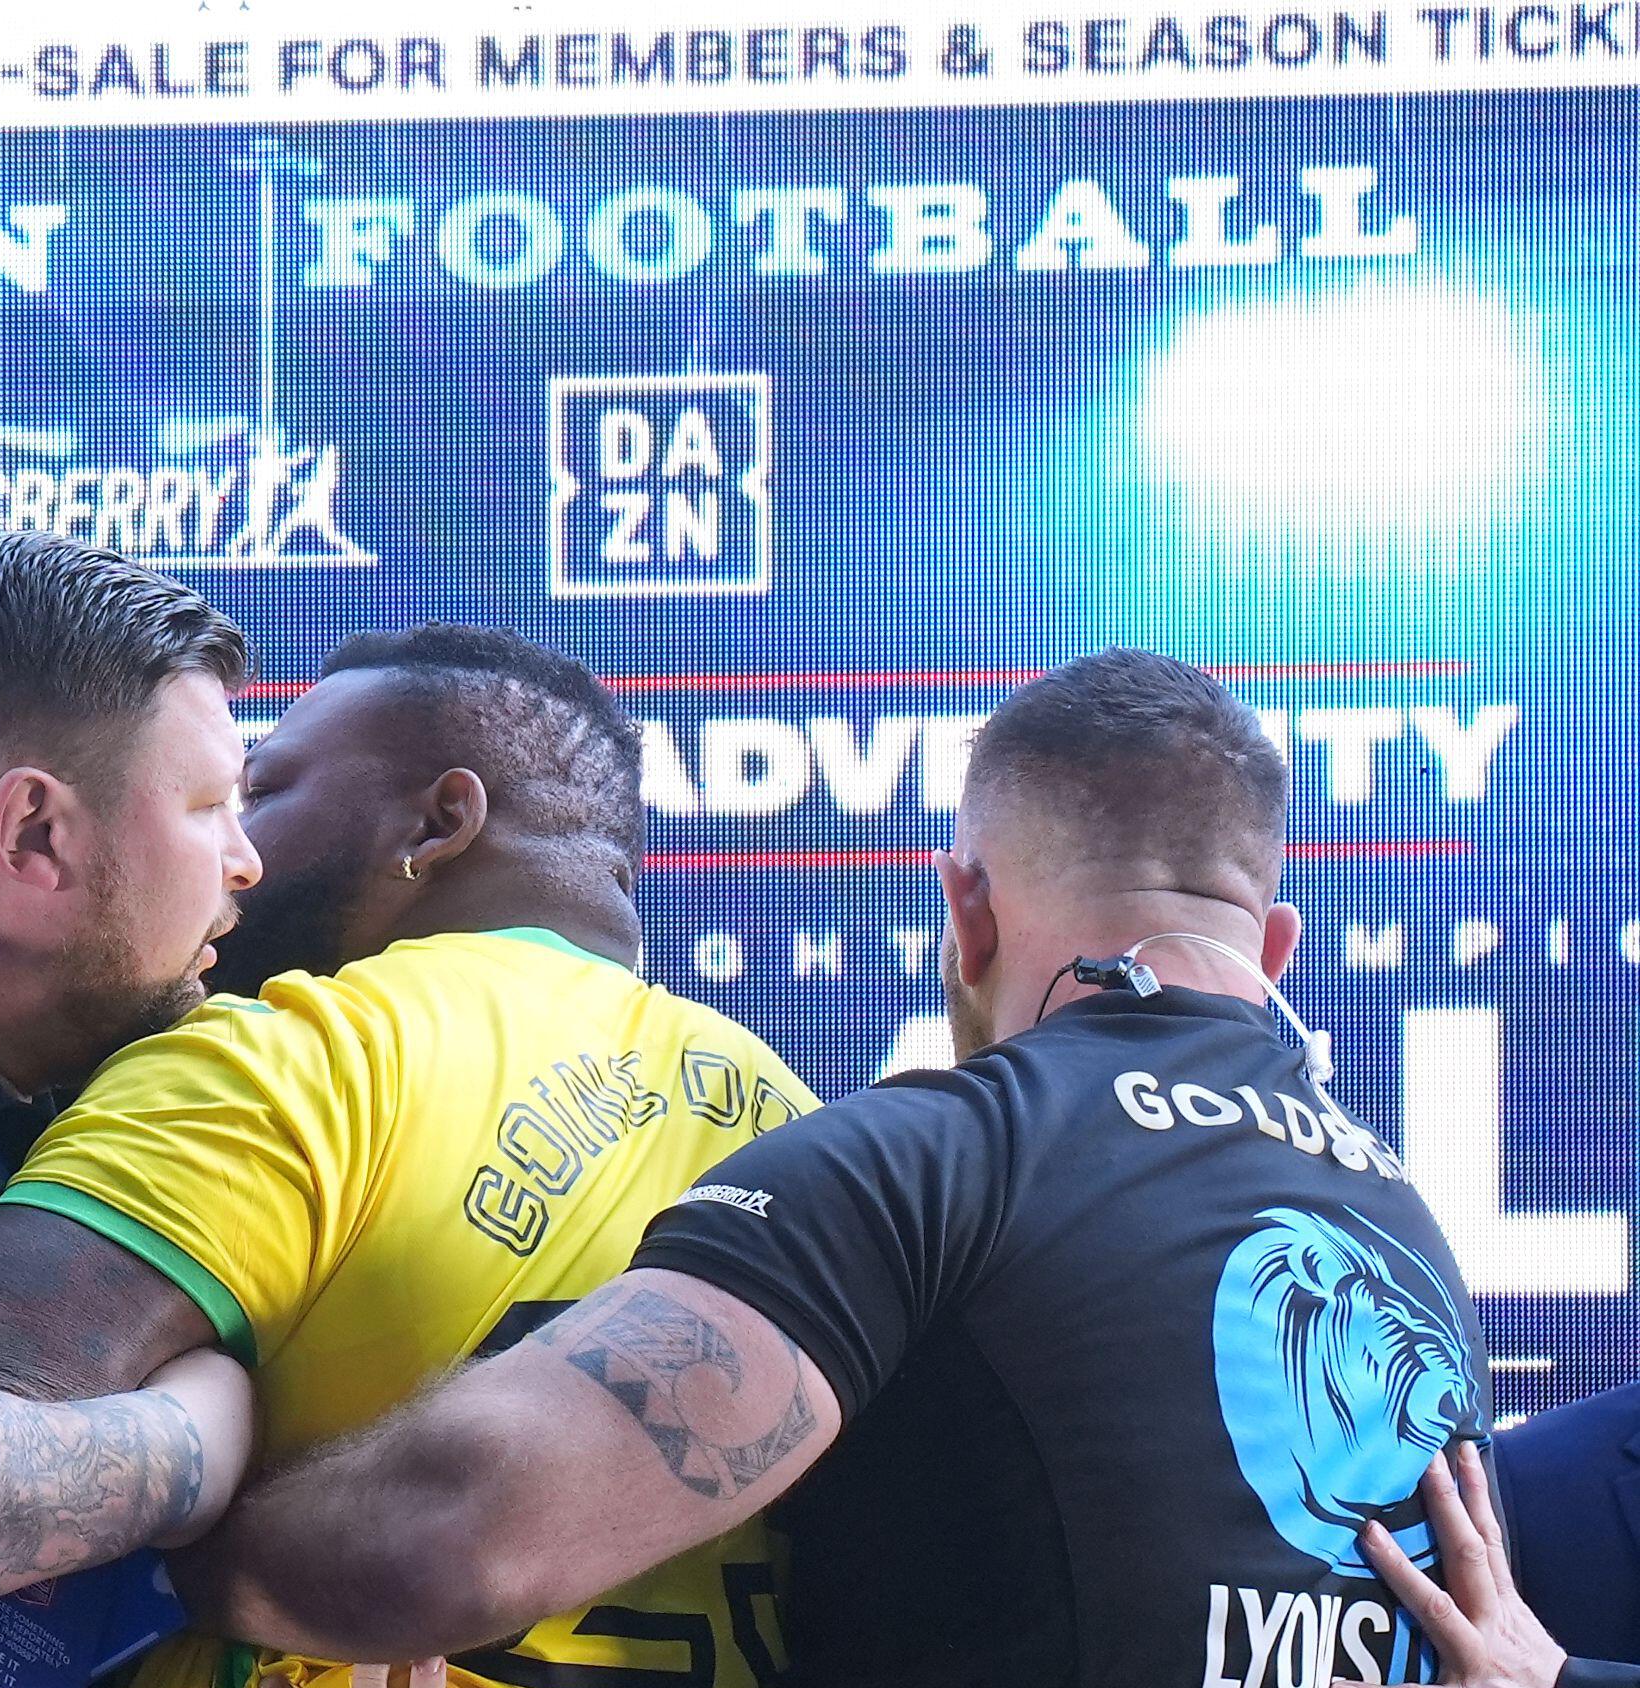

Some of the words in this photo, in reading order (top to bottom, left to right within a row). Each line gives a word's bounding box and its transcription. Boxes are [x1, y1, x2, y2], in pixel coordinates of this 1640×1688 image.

[280, 36, 446, 94] FOR
[477, 25, 909, 91] MEMBERS
[938, 24, 993, 79] &
[1022, 10, 1388, 77] SEASON
[1417, 2, 1640, 65] TICK
[302, 166, 1417, 290] FOOTBALL
[4, 1673, 17, 1688] IT
[7, 1658, 20, 1672] IT
